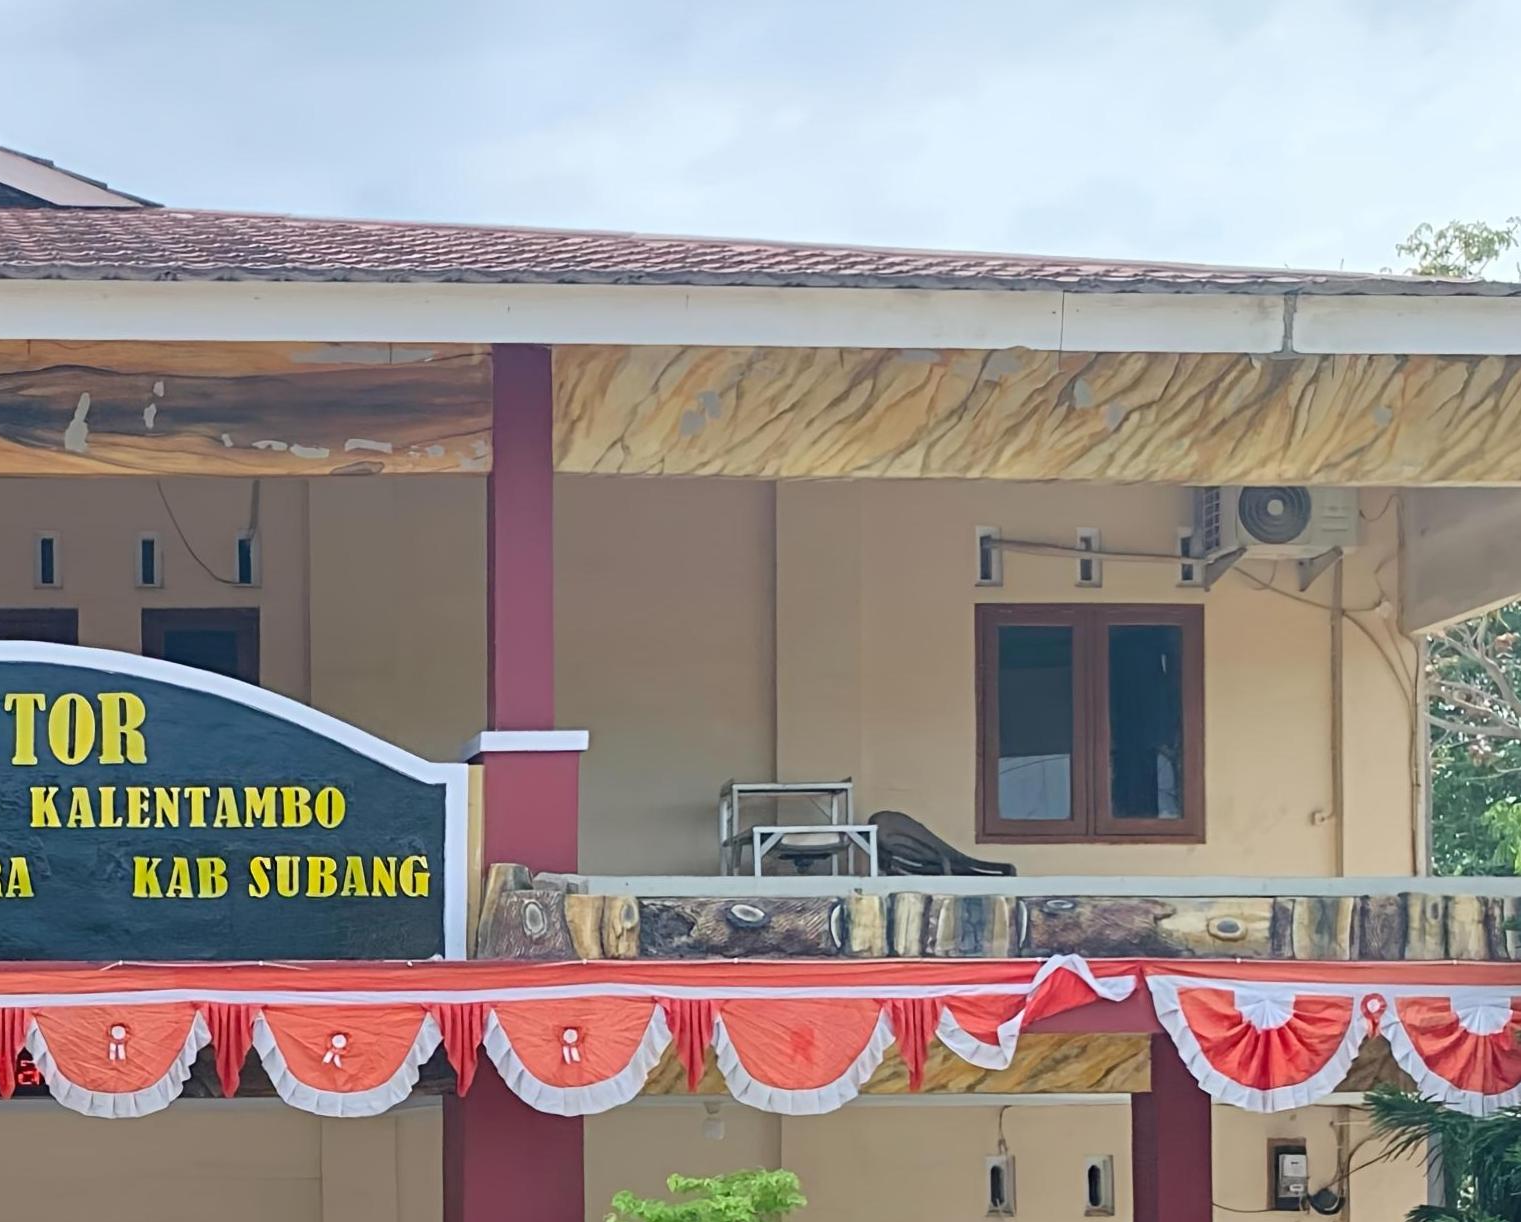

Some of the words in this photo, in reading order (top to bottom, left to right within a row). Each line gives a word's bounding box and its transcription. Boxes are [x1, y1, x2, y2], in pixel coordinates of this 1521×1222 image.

[30, 786, 346, 828] KALENTAMBO
[132, 856, 229, 898] KAB
[248, 856, 430, 898] SUBANG
